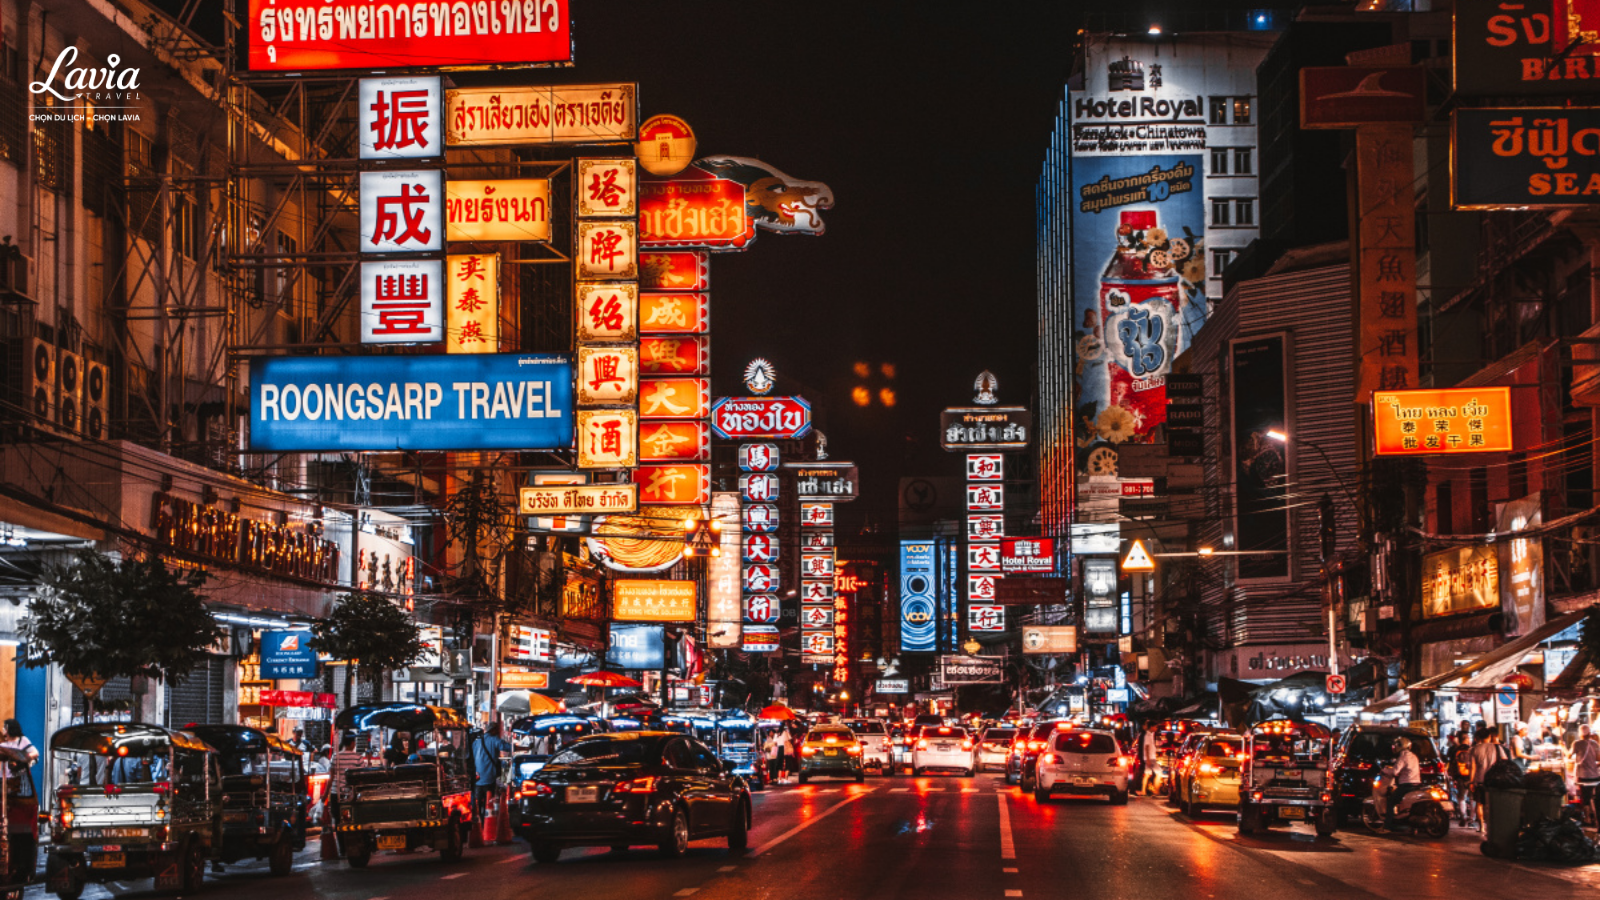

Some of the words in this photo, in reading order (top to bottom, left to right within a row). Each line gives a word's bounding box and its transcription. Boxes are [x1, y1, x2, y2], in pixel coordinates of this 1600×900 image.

[1076, 96, 1136, 118] Hotel
[1140, 95, 1203, 120] Royal
[1147, 181, 1169, 201] 10
[371, 90, 431, 334] 振成豐
[260, 382, 442, 422] ROONGSARP
[453, 381, 561, 420] TRAVEL
[528, 491, 558, 508] บริษัท
[600, 490, 628, 507] จำกัด
[977, 460, 994, 627] 和成興大金行
[1002, 556, 1025, 565] Hotel
[1027, 555, 1052, 565] Royal
